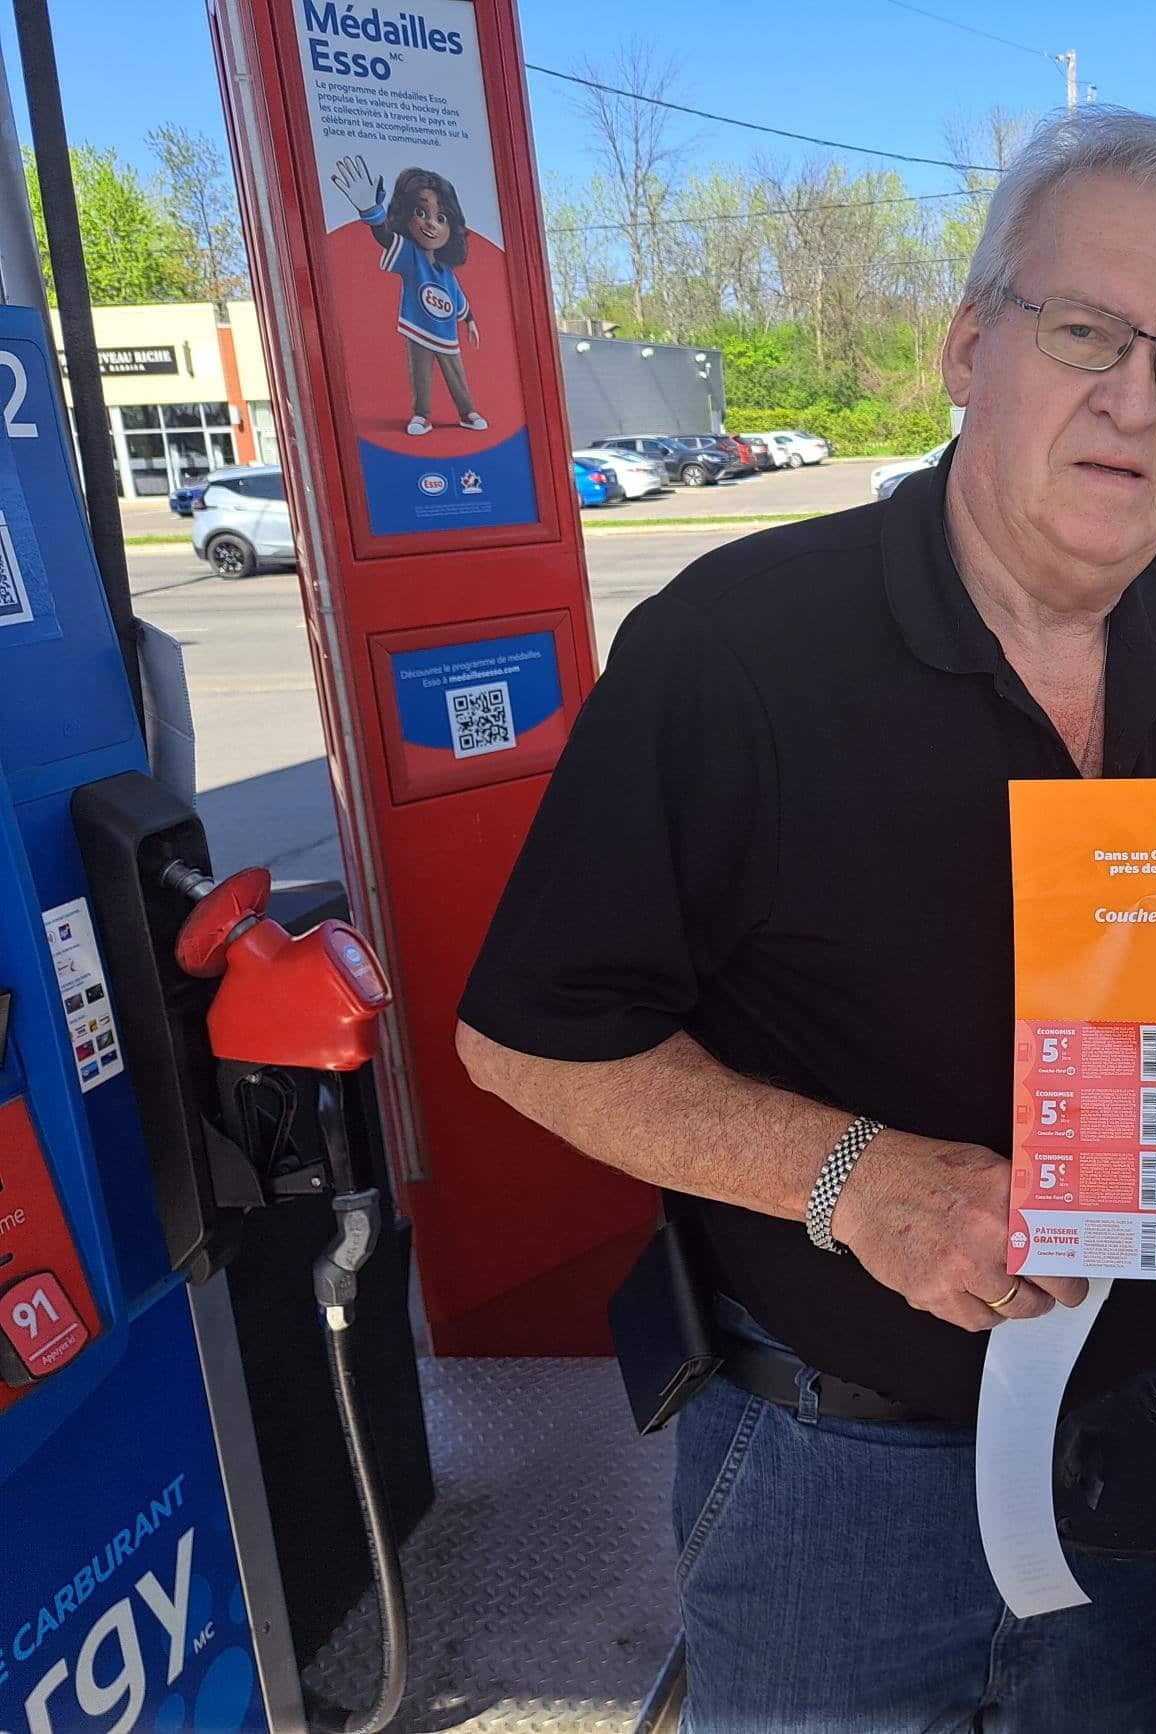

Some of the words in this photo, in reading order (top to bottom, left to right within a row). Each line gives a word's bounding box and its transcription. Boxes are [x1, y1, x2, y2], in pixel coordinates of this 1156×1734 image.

[303, 0, 463, 55] Médailles
[309, 38, 391, 80] Esso
[389, 53, 404, 62] MC
[315, 80, 326, 89] Le
[328, 83, 376, 95] programme
[378, 88, 388, 96] de
[429, 94, 447, 104] Esso
[318, 93, 354, 104] propulse
[355, 96, 368, 105] les
[369, 98, 399, 109] valeurs
[400, 102, 411, 110] du
[412, 104, 439, 115] hockey
[441, 107, 459, 117] dans
[319, 103, 331, 112] les
[419, 114, 426, 123] le
[428, 118, 446, 127] pays
[323, 126, 345, 136] glace
[347, 129, 356, 137] et
[358, 130, 377, 139] dans
[379, 132, 386, 140] la
[1094, 850, 1129, 861] Dans
[1131, 851, 1149, 861] un
[1110, 863, 1140, 876] près
[1033, 1237, 1080, 1245] GRATUITE
[1035, 1226, 1079, 1235] PÂTISSERIE
[12, 1288, 60, 1339] 91
[12, 1473, 185, 1661] CARBURANT
[192, 1621, 216, 1654] MC
